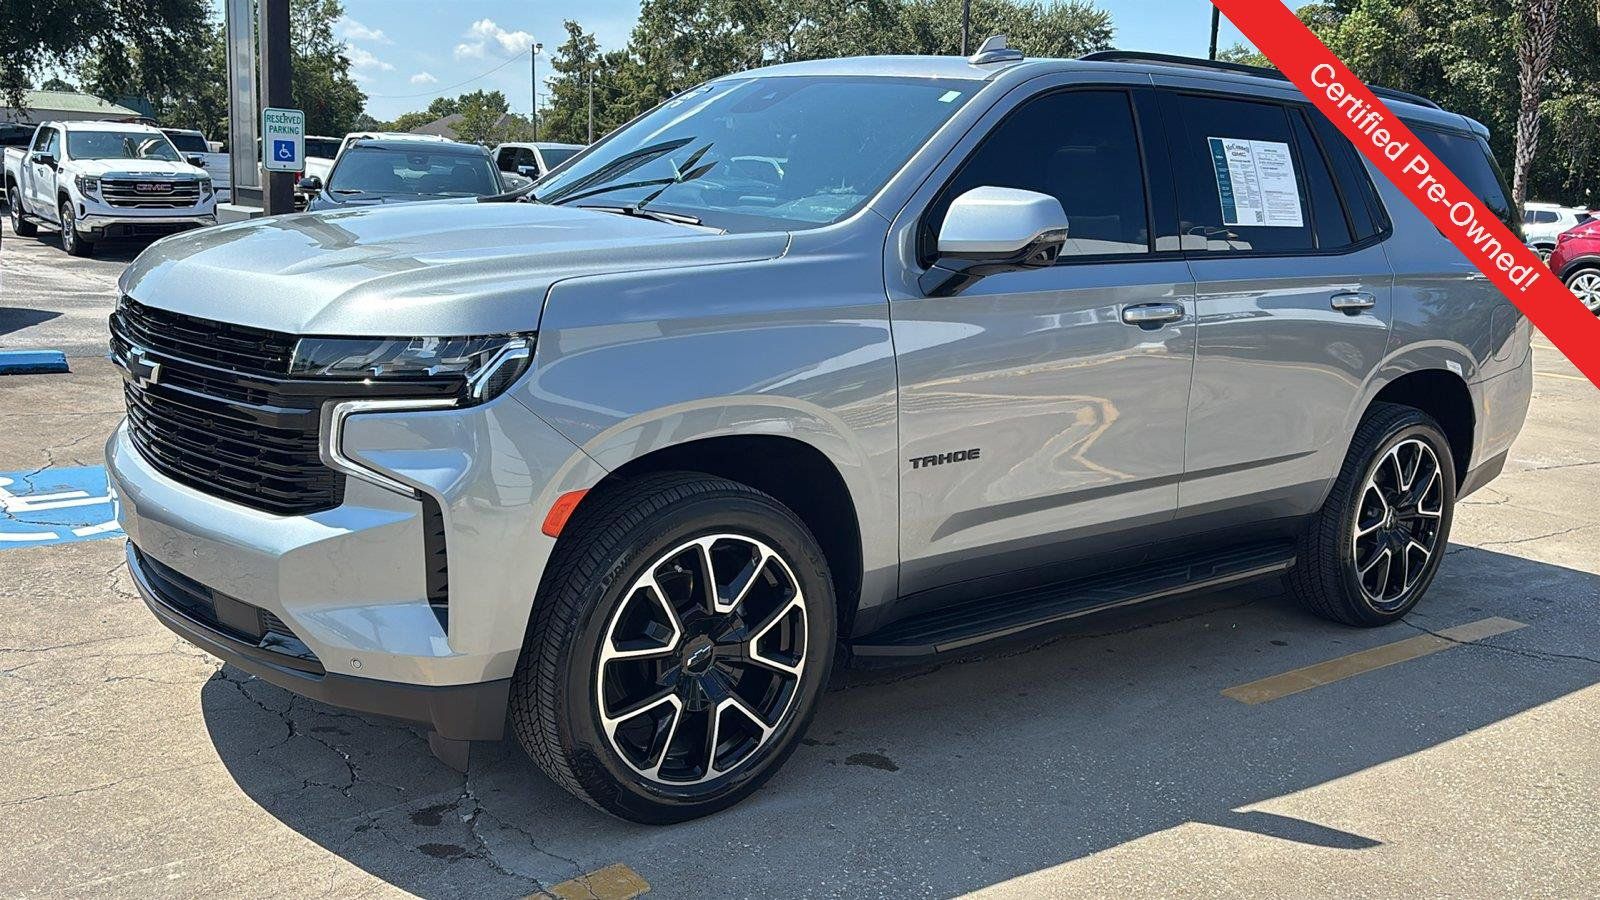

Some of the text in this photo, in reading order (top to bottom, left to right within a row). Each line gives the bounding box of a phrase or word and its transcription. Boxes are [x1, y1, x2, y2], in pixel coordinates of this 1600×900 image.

[266, 114, 302, 125] RESERVED
[269, 125, 300, 135] PARKING
[136, 183, 172, 191] GMC
[909, 448, 981, 469] TAHOE
